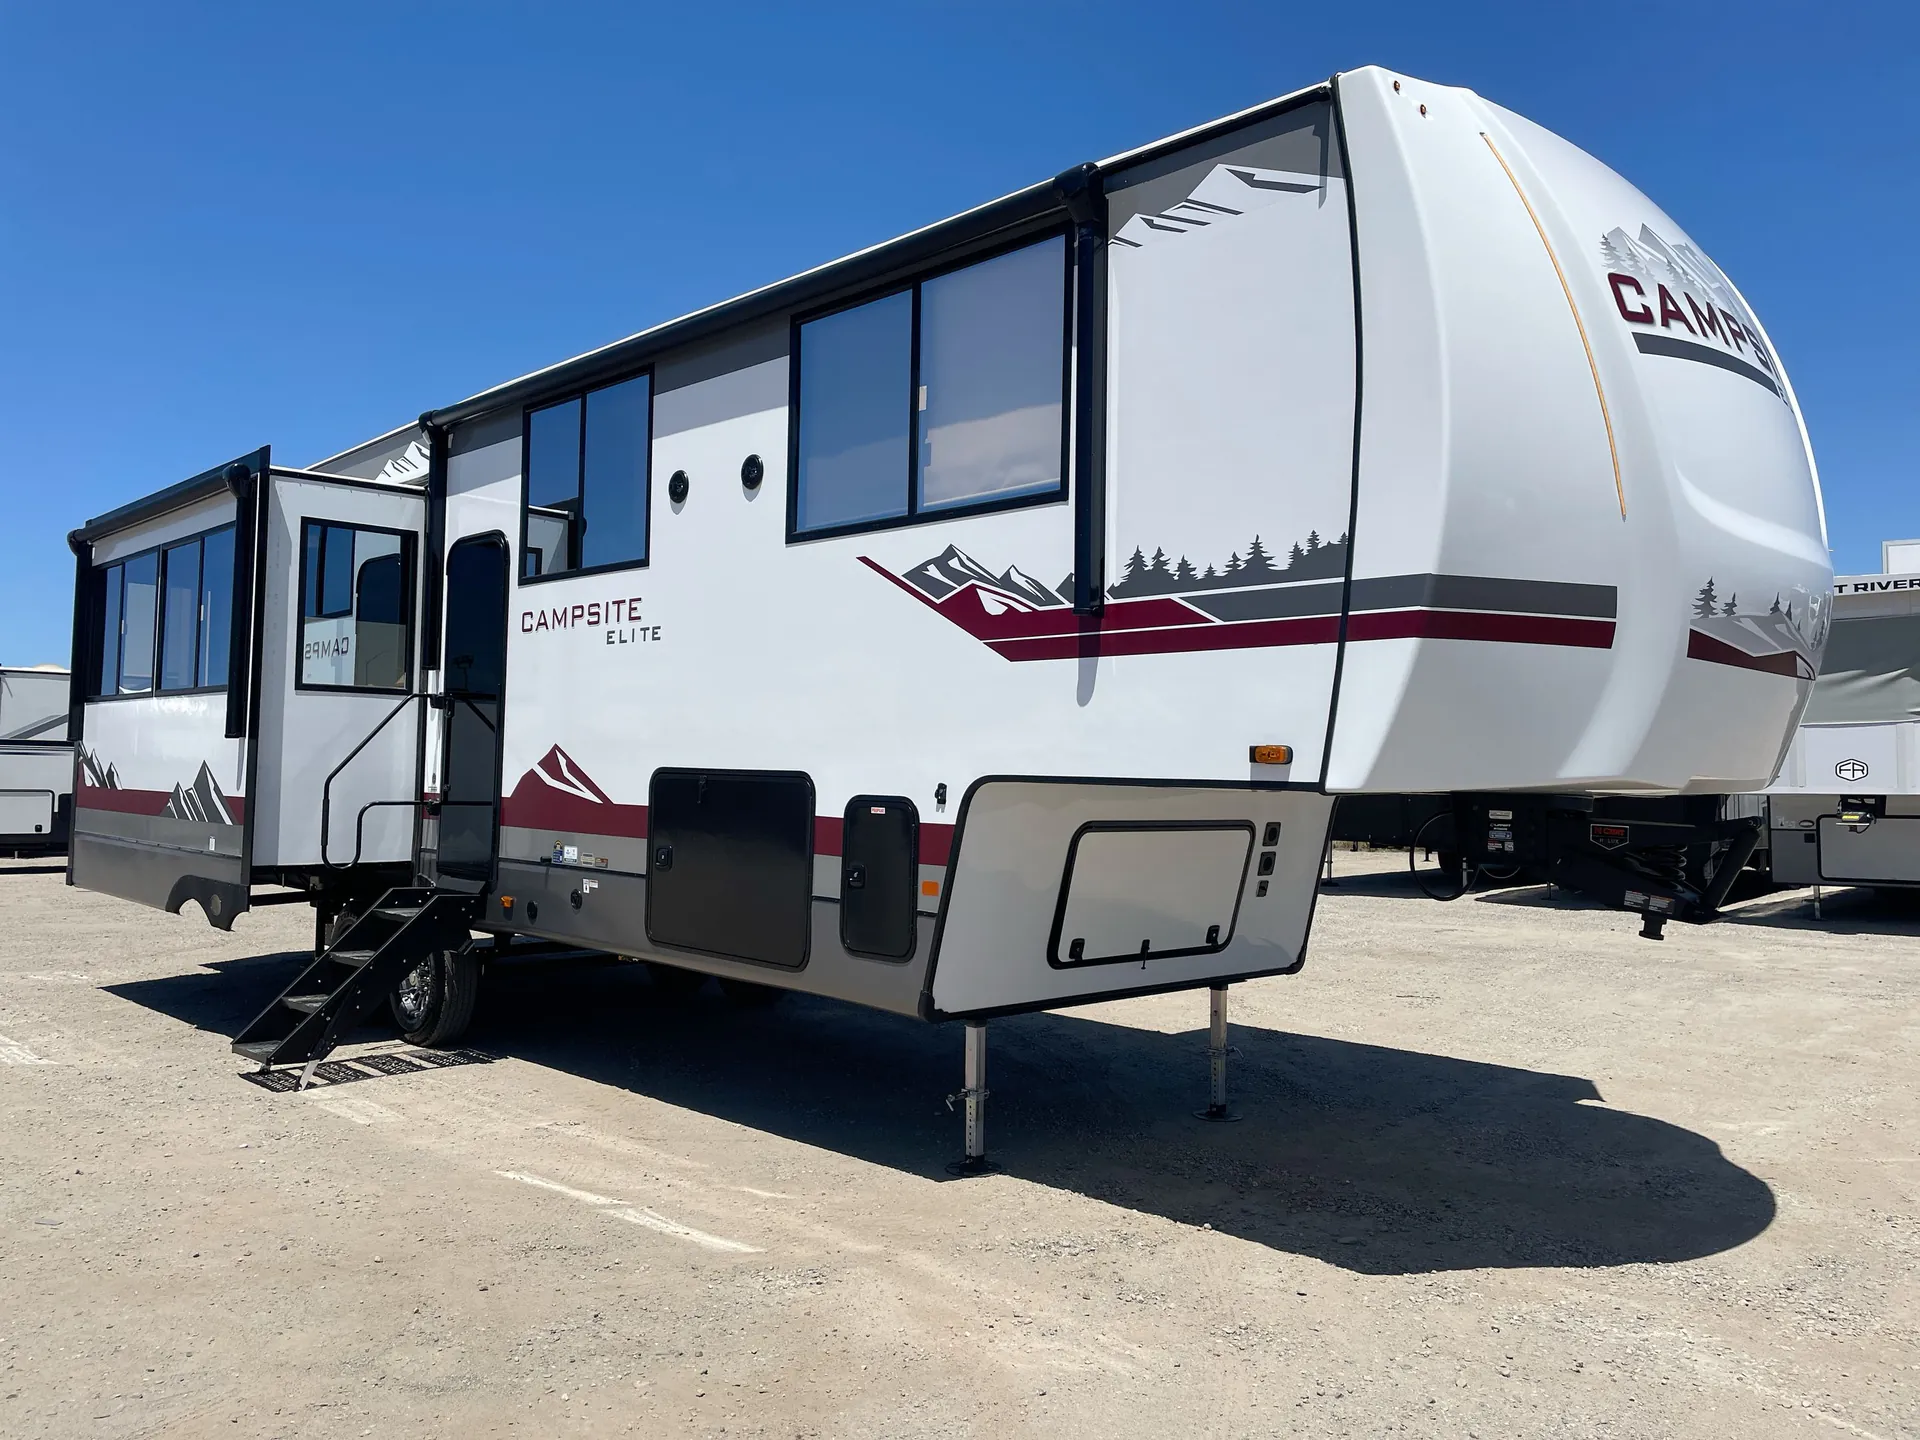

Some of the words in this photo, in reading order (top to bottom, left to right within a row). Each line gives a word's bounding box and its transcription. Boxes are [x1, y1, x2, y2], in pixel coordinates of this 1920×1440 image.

[1853, 578, 1920, 593] RIVER
[521, 597, 642, 633] CAMPSITE
[606, 626, 662, 645] ELITE
